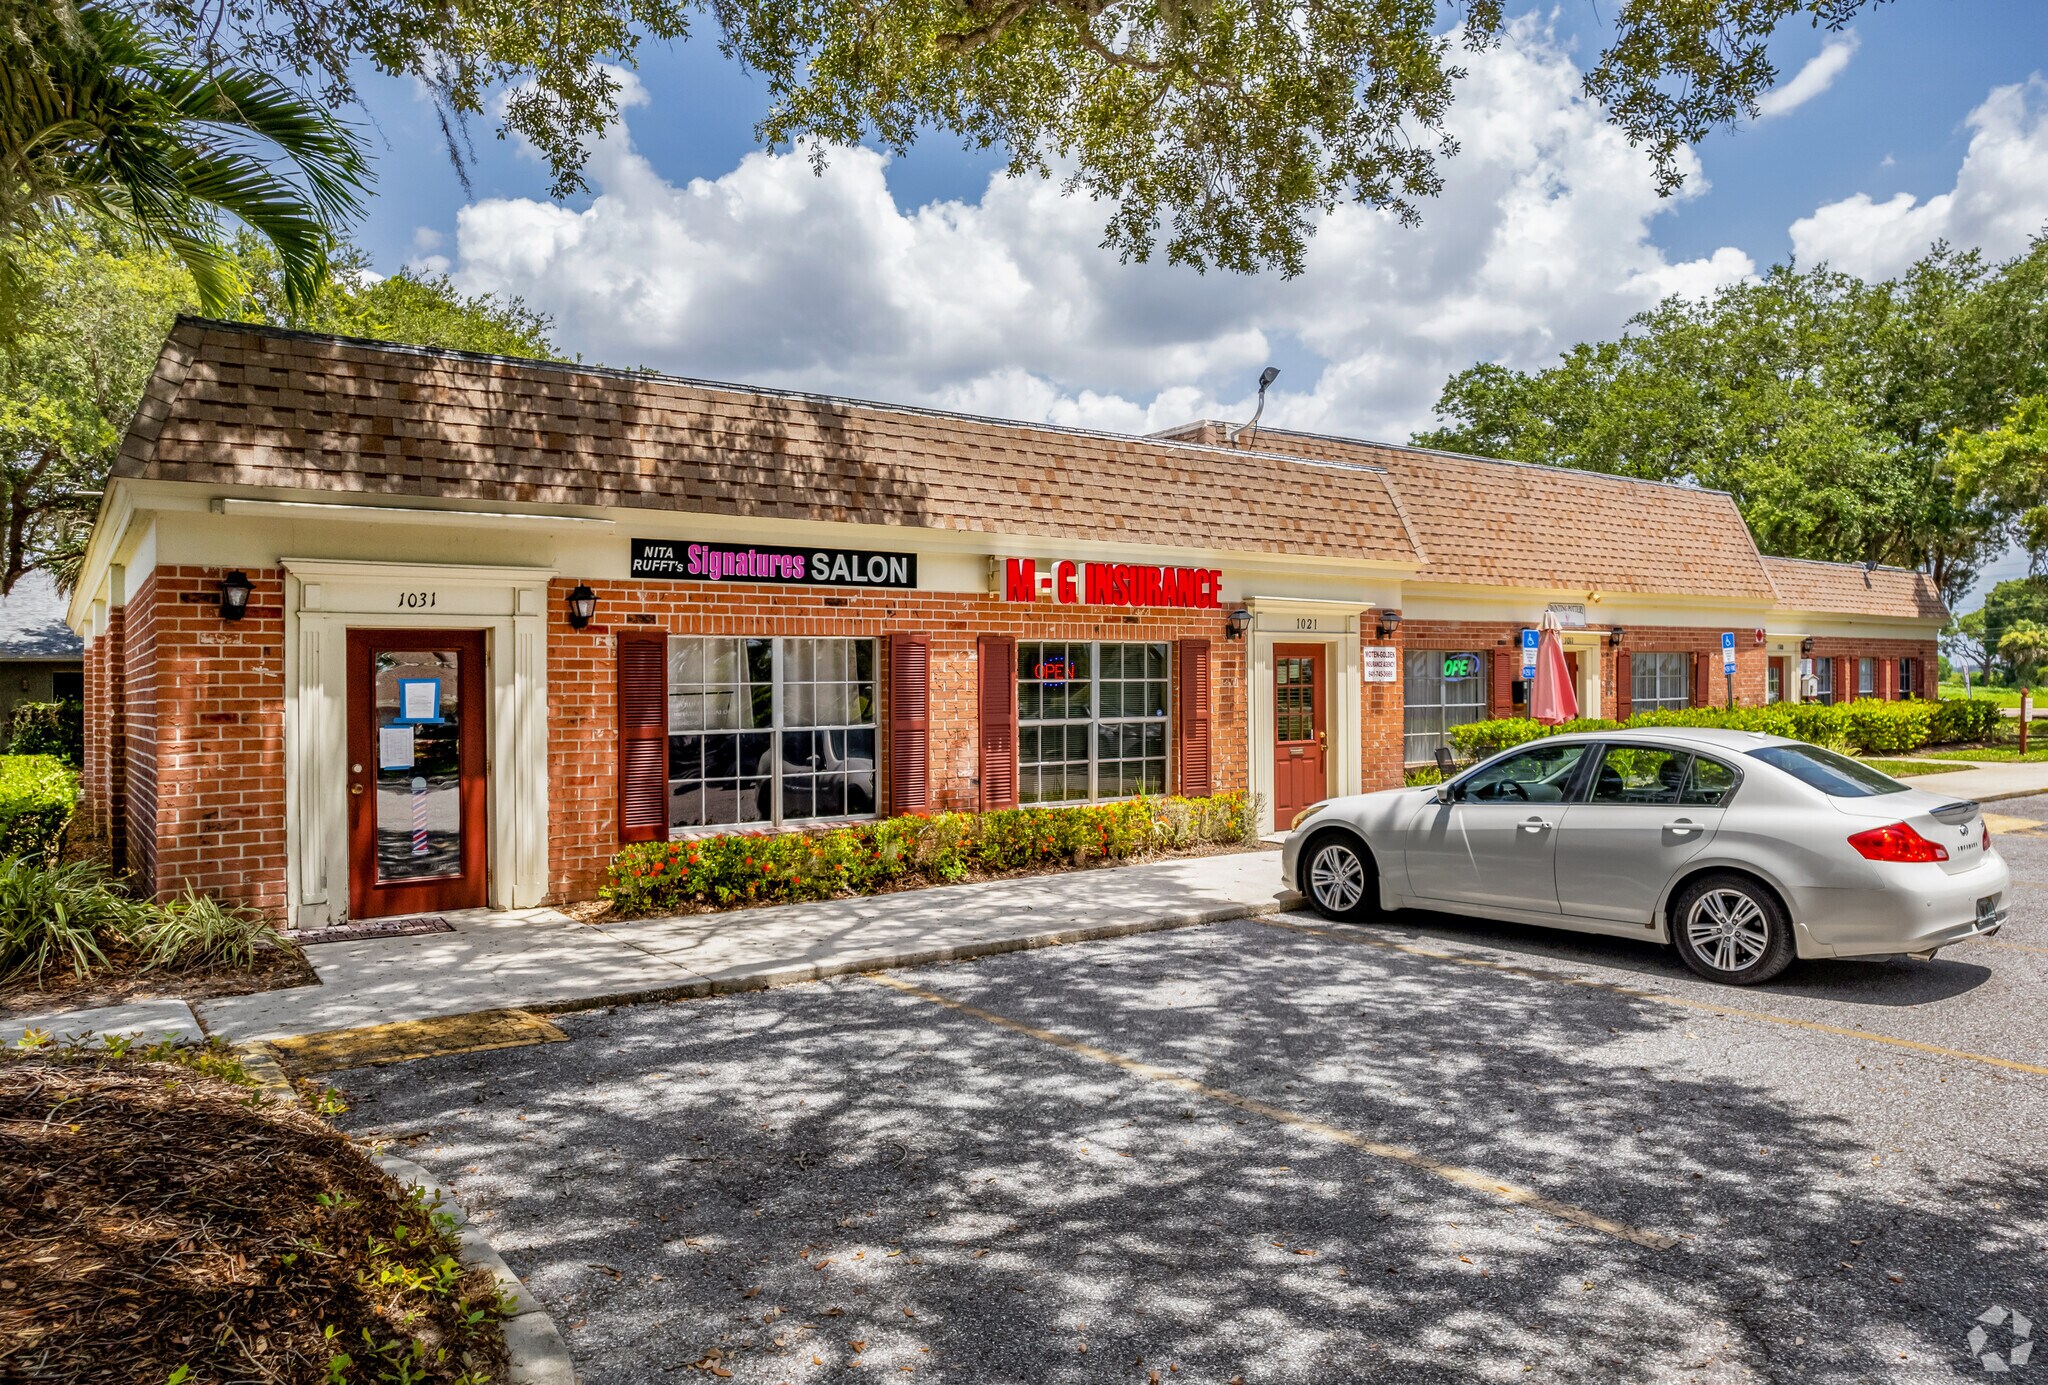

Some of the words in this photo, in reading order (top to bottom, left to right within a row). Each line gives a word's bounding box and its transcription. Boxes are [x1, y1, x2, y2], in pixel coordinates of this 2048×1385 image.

[643, 546, 674, 559] NITA
[632, 558, 684, 573] RUFFT's
[687, 544, 805, 580] Signatures
[811, 552, 908, 584] SALON
[1084, 562, 1223, 609] INSURANCE
[398, 592, 436, 608] 1031
[1296, 618, 1317, 630] 1021
[1034, 663, 1075, 680] OPEN
